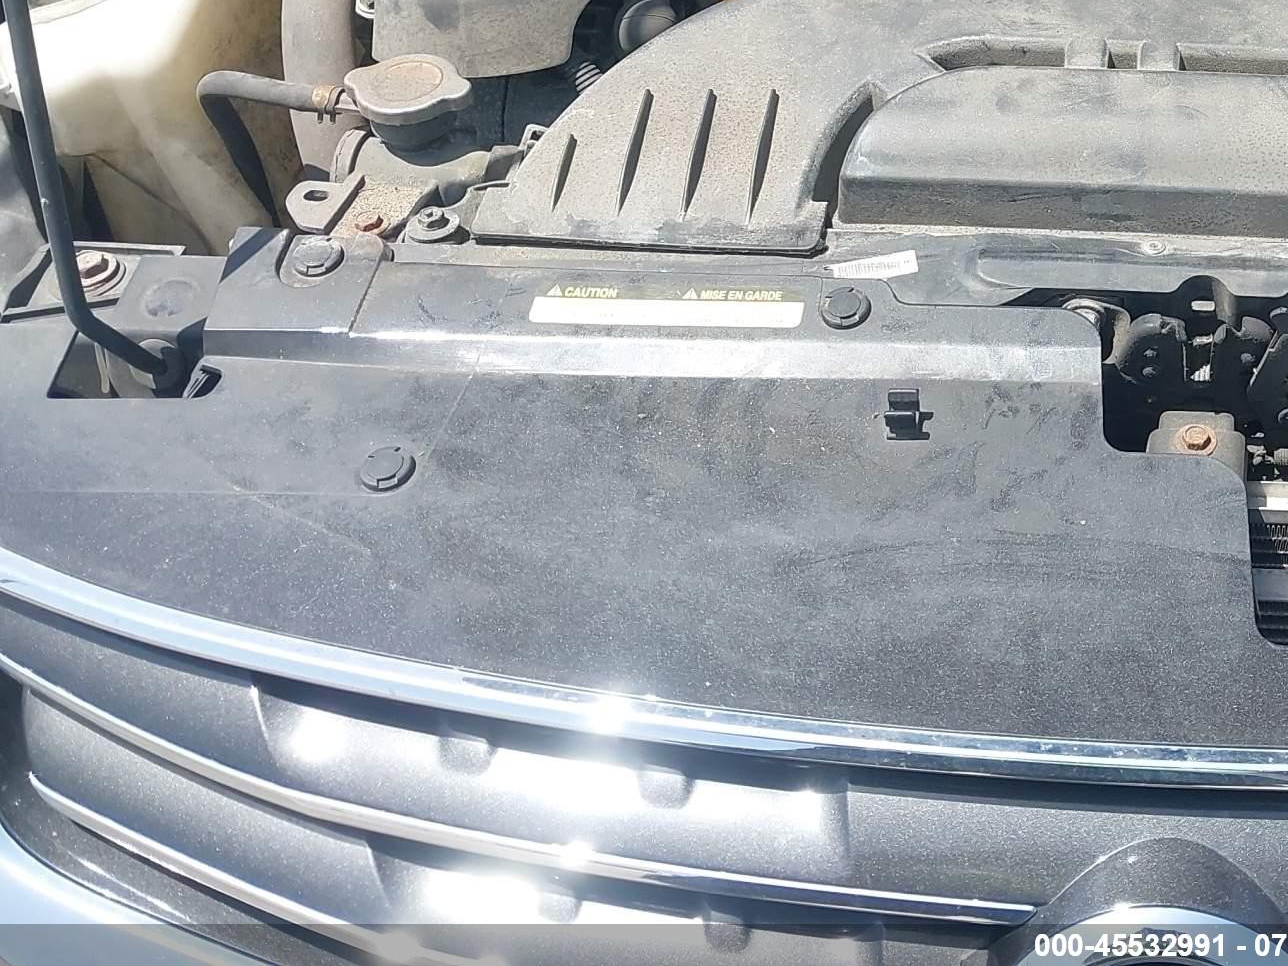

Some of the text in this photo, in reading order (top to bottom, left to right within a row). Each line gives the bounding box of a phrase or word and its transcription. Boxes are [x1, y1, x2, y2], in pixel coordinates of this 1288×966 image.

[564, 286, 618, 299] CAUTION
[700, 289, 782, 301] MISE EN GARDE
